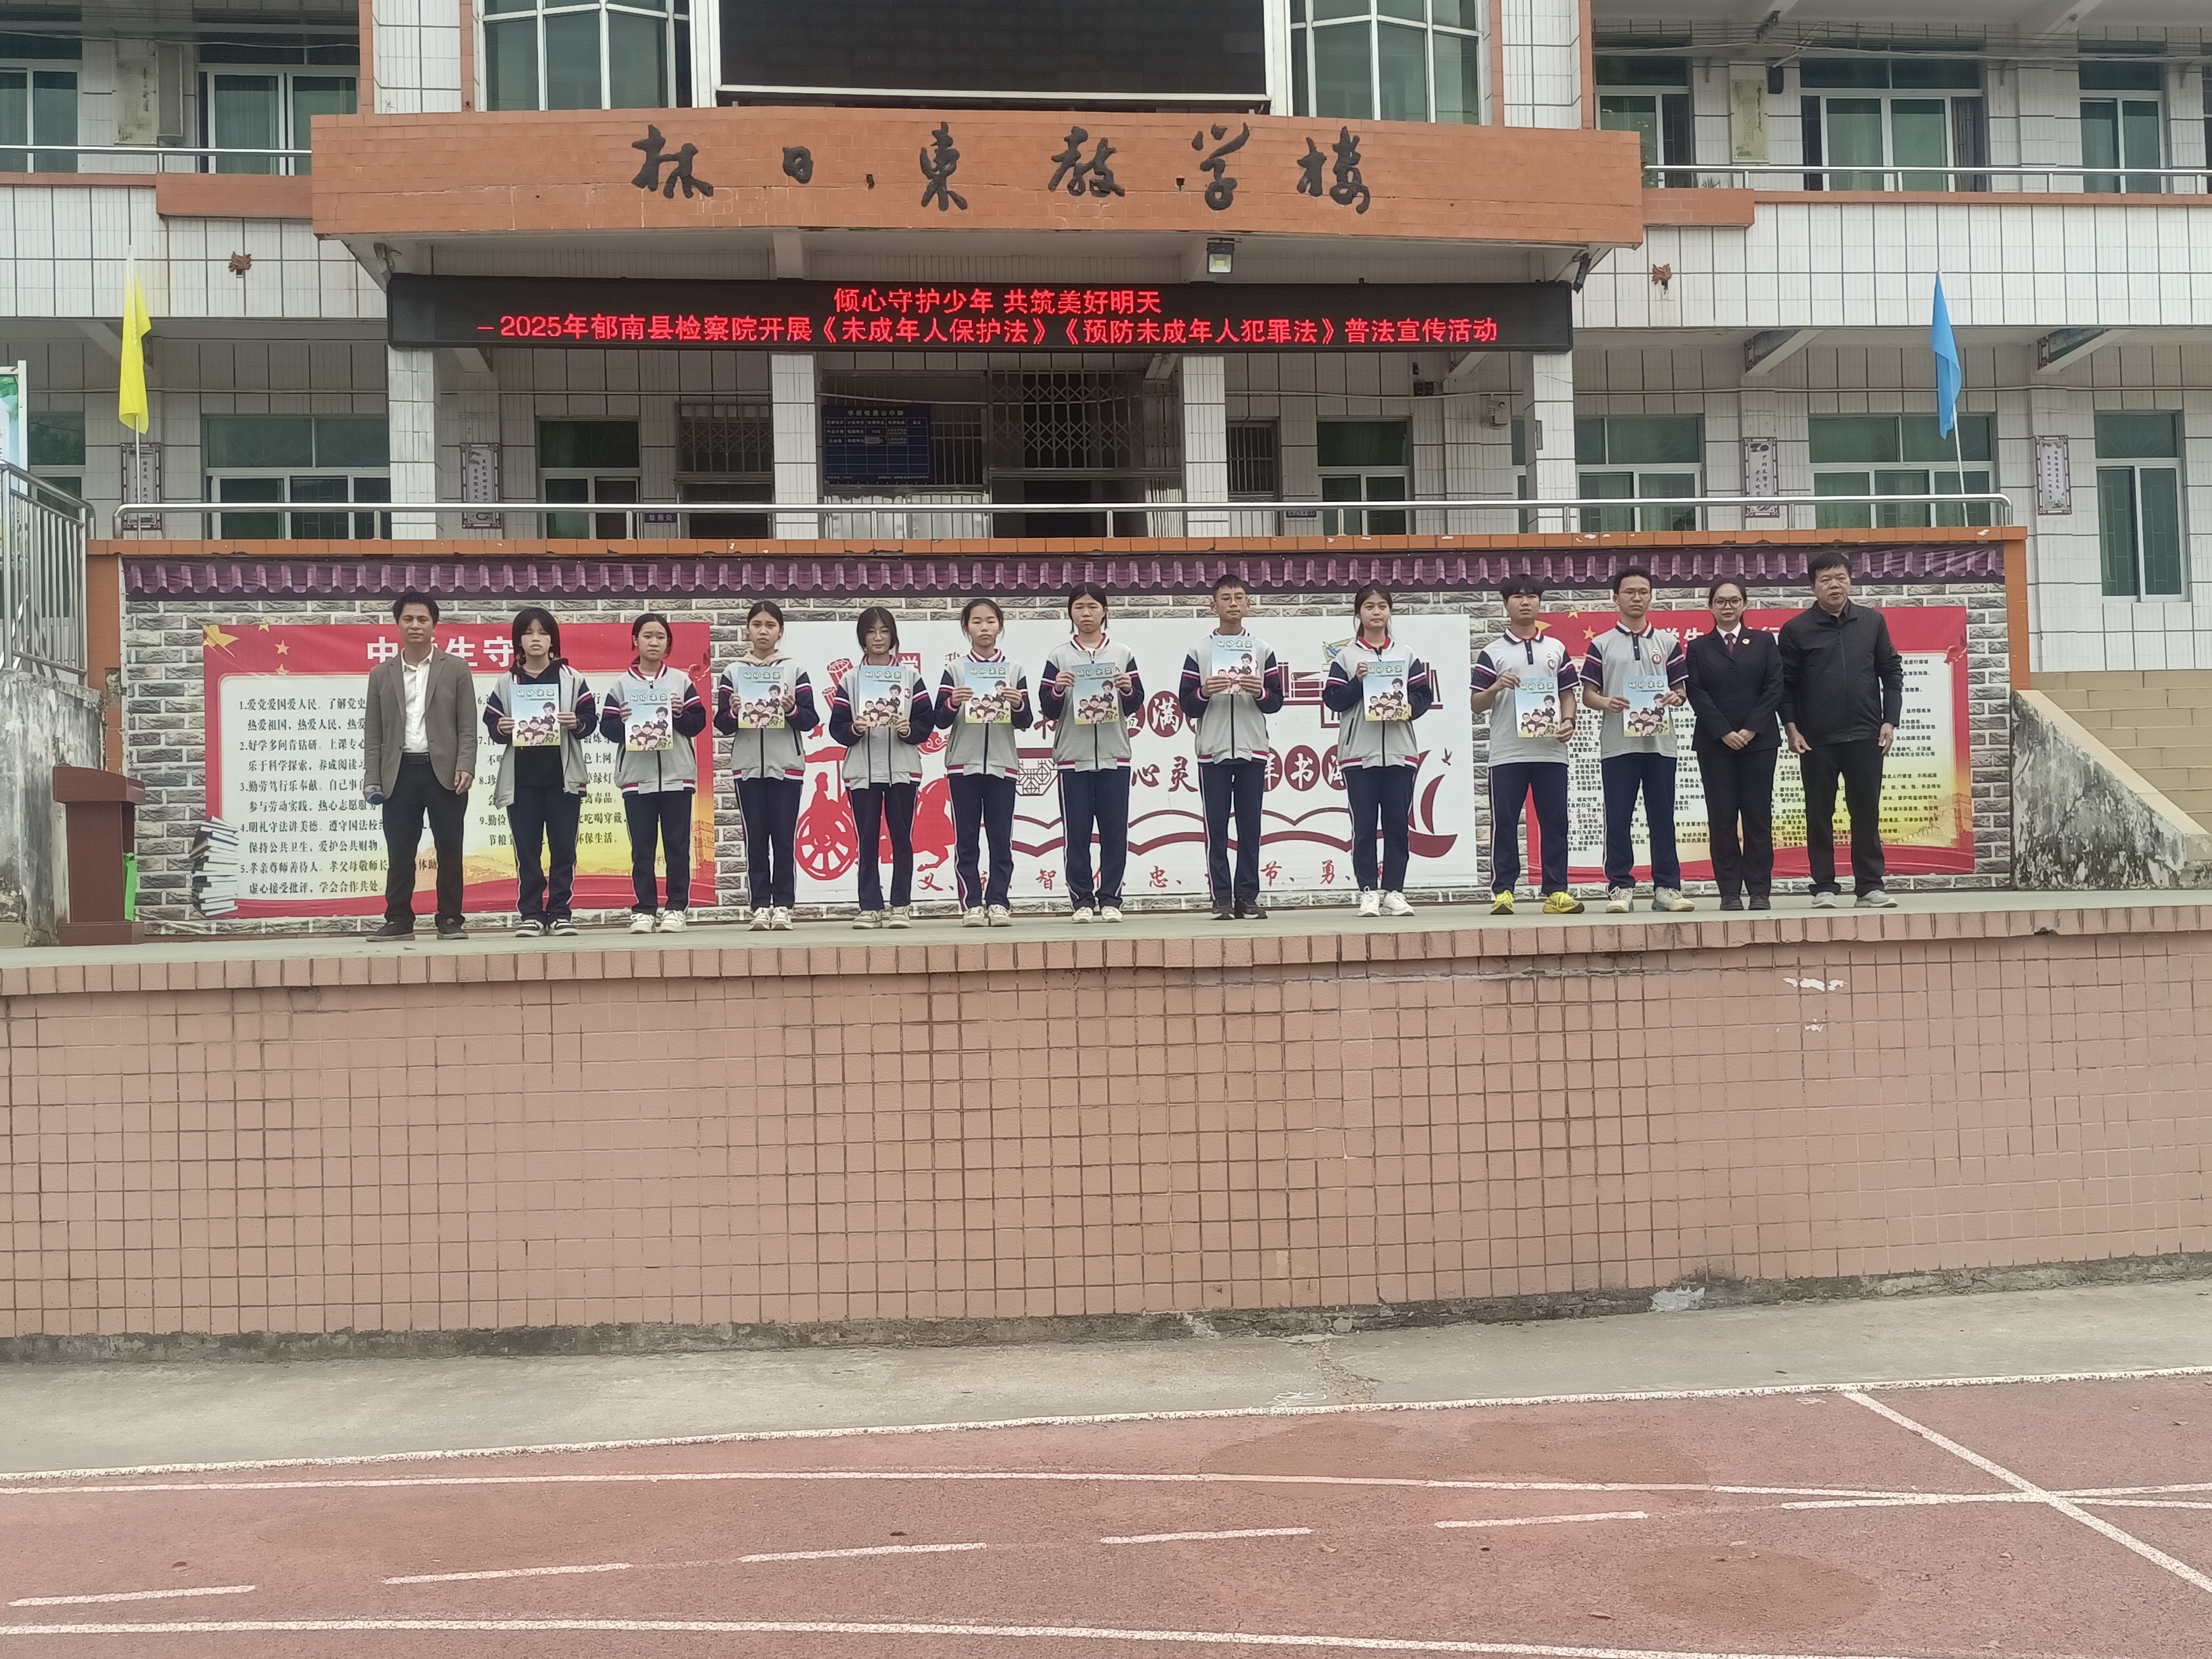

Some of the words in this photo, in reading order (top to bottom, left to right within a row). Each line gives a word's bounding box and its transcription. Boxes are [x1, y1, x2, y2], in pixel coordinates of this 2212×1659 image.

[833, 288, 993, 313] 倾心守护少年
[1003, 289, 1162, 314] 共筑美好明天
[1131, 756, 1198, 792] 心灵
